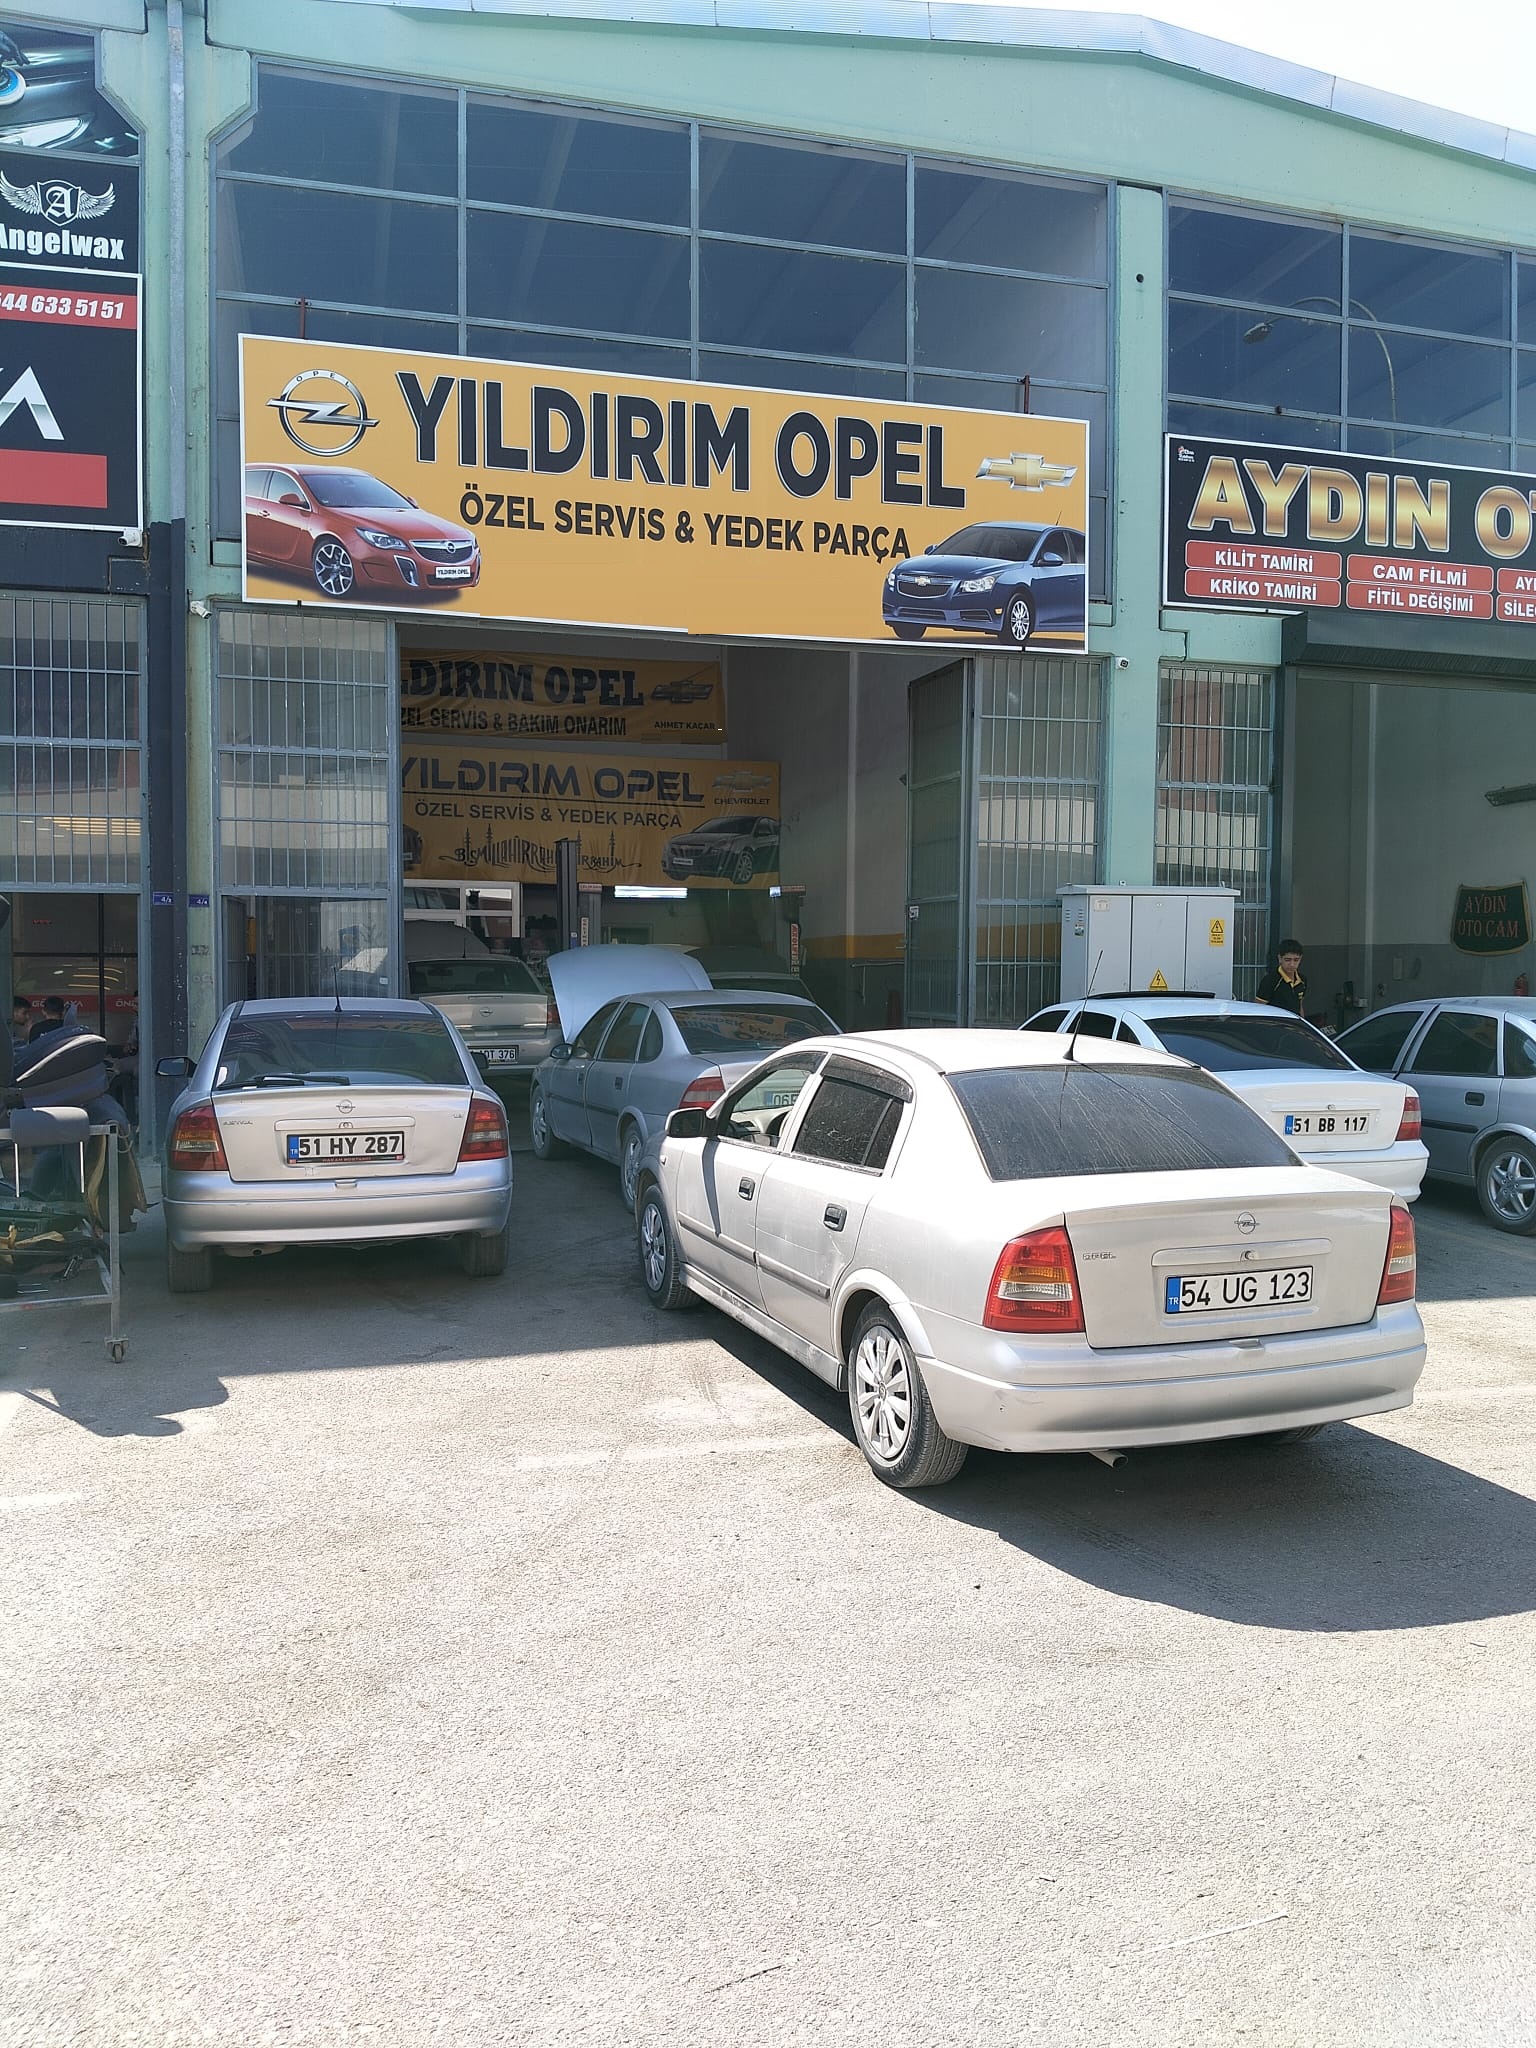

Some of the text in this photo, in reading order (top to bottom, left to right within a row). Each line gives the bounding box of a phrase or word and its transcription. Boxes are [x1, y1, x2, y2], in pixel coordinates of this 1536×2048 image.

[31, 295, 72, 315] 633
[395, 371, 967, 509] YILDIRIM OPEL
[1187, 455, 1536, 560] AYDIN O
[459, 483, 545, 531] ÖZEL
[675, 510, 695, 543] &
[703, 513, 805, 552] YEDEK
[813, 521, 911, 564] PARÇA
[1215, 547, 1314, 573] KİLİT TAMİRİ
[1373, 563, 1468, 587] CAM FİLMİ
[1515, 576, 1536, 592] AY
[1210, 575, 1318, 601] KRİKO TAMİRİ
[1367, 586, 1405, 608] FİTİL
[1504, 600, 1536, 618] SİLE
[543, 665, 645, 707] OPEL
[493, 711, 505, 732] &
[507, 713, 560, 735] BAKIM
[563, 714, 627, 737] ONARIM
[654, 721, 683, 729] AHMET
[402, 755, 705, 803] YILDIRIM OPEL
[714, 797, 771, 805] CHEVROLET
[414, 798, 682, 832] ÖZEL SERVİS & YEDEK PARÇA
[1464, 894, 1507, 914] AYDIN
[1457, 919, 1519, 938] OTO CAM
[498, 1049, 515, 1059] 376
[1293, 1116, 1367, 1133] 51 BB 117
[299, 1135, 400, 1156] 51 HY 287
[1180, 1271, 1310, 1307] 54 UG 123
[1168, 1296, 1179, 1305] TR
